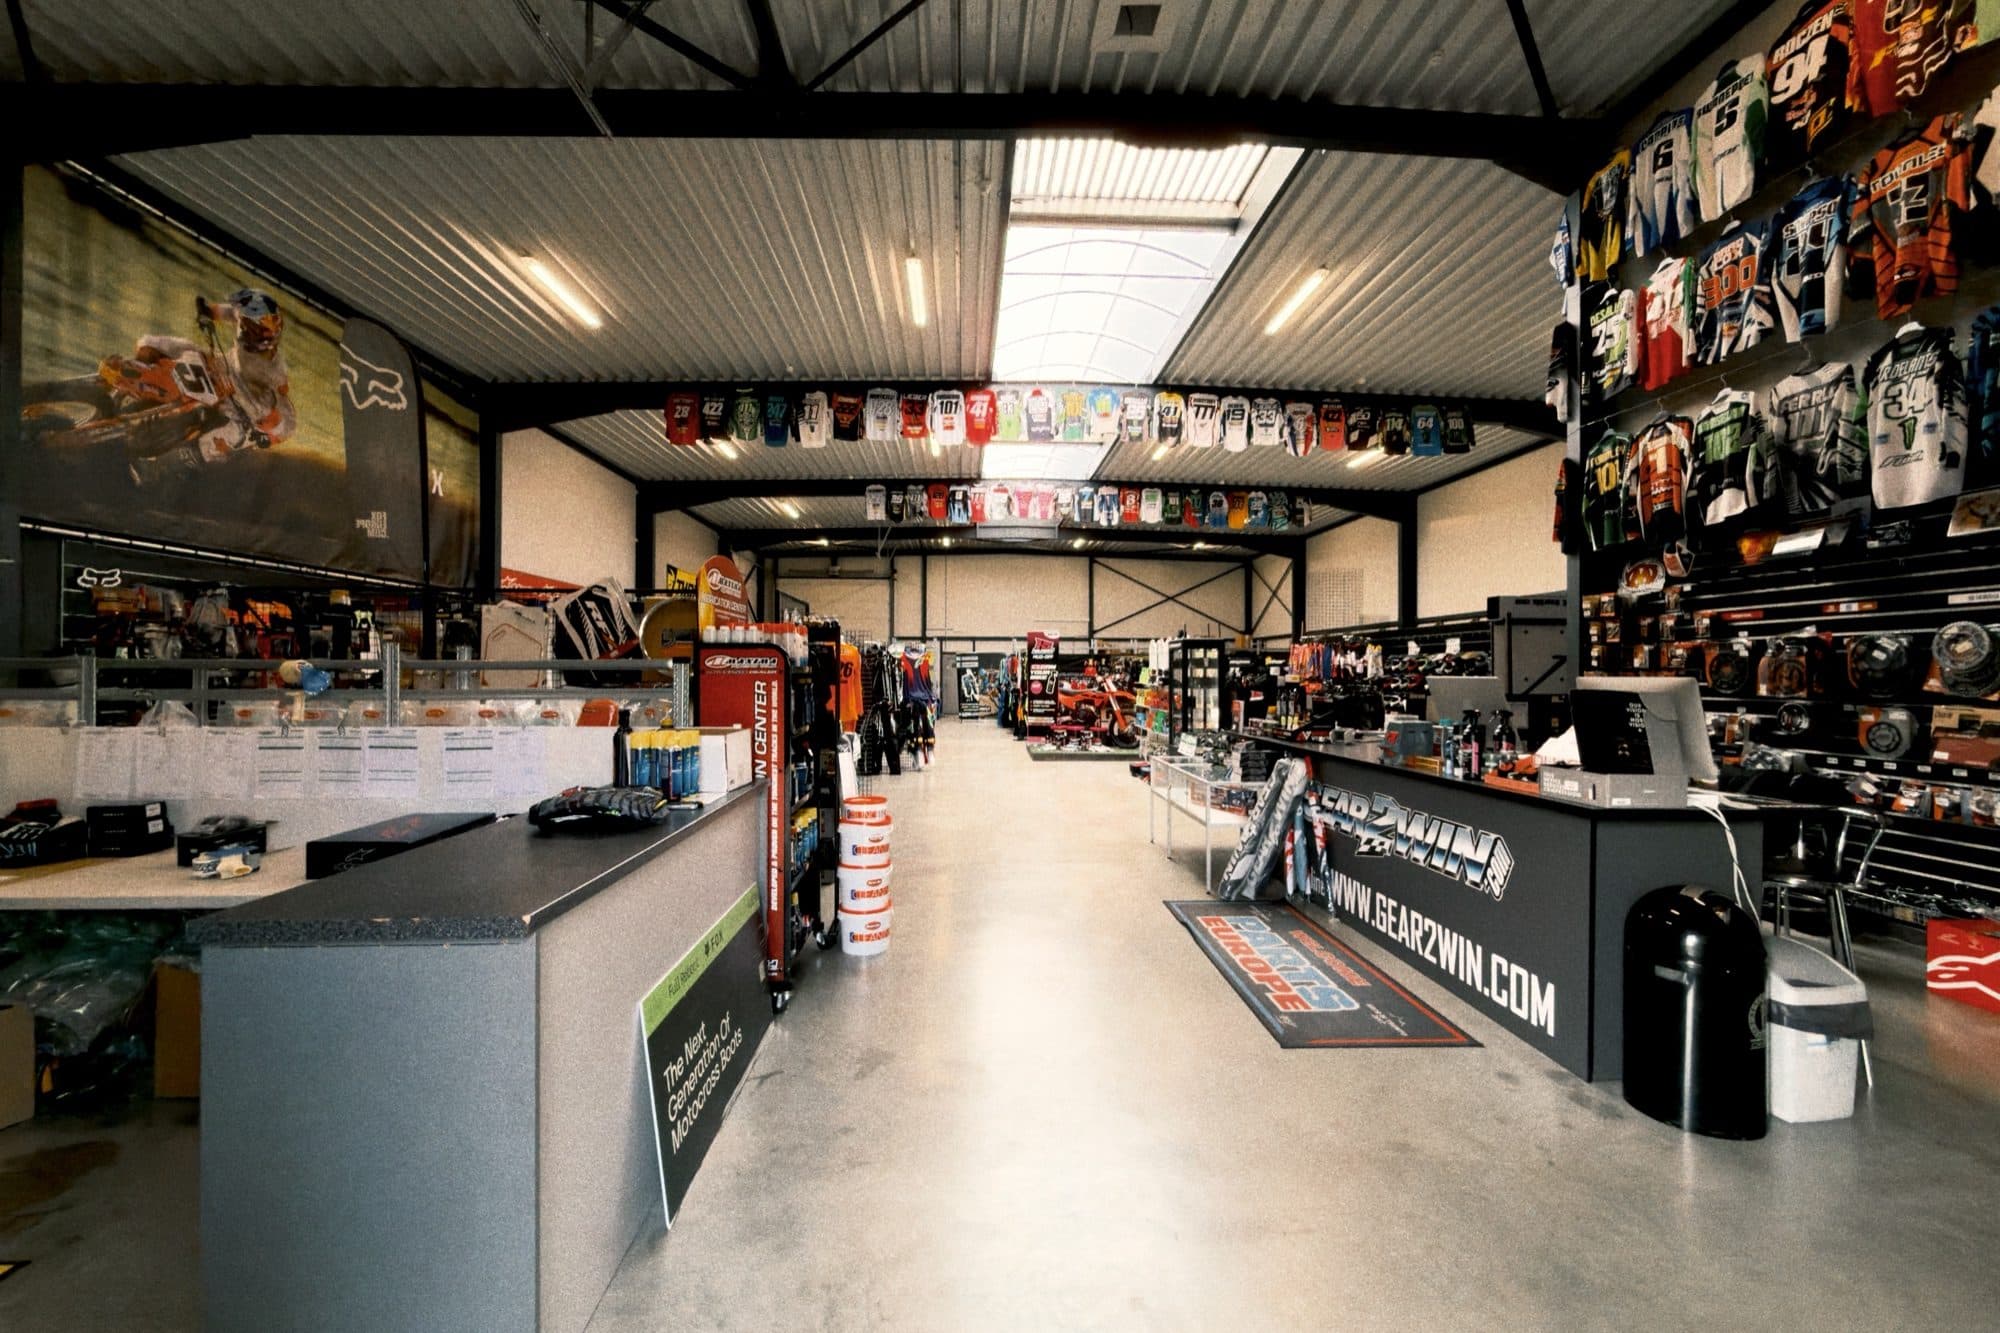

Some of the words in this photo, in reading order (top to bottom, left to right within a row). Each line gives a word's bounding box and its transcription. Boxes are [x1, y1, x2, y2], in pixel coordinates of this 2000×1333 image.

[1774, 14, 1834, 65] ROCZEN
[1771, 34, 1830, 104] 94
[1714, 96, 1740, 138] 5
[1652, 138, 1674, 174] 6
[1702, 255, 1757, 311] 300
[702, 402, 724, 416] 422
[939, 400, 959, 415] 101
[969, 402, 990, 417] 41
[1193, 404, 1216, 420] 777
[1225, 408, 1245, 421] 19
[1883, 374, 1933, 420] 34
[1417, 417, 1434, 430] 64
[1595, 461, 1618, 496] 10
[1648, 446, 1667, 474] 1
[754, 680, 767, 756] CENTER
[1197, 916, 1313, 1012] EUROPE
[1220, 916, 1360, 1011] PARTS
[1331, 868, 1556, 1038] WWW.GEAR2WIN.COM
[663, 1057, 685, 1093] The
[684, 1020, 707, 1066] Next
[668, 1033, 720, 1122] Generation
[720, 1010, 731, 1041] Of
[671, 1064, 720, 1155] Motocross
[720, 1027, 743, 1072] Boots
